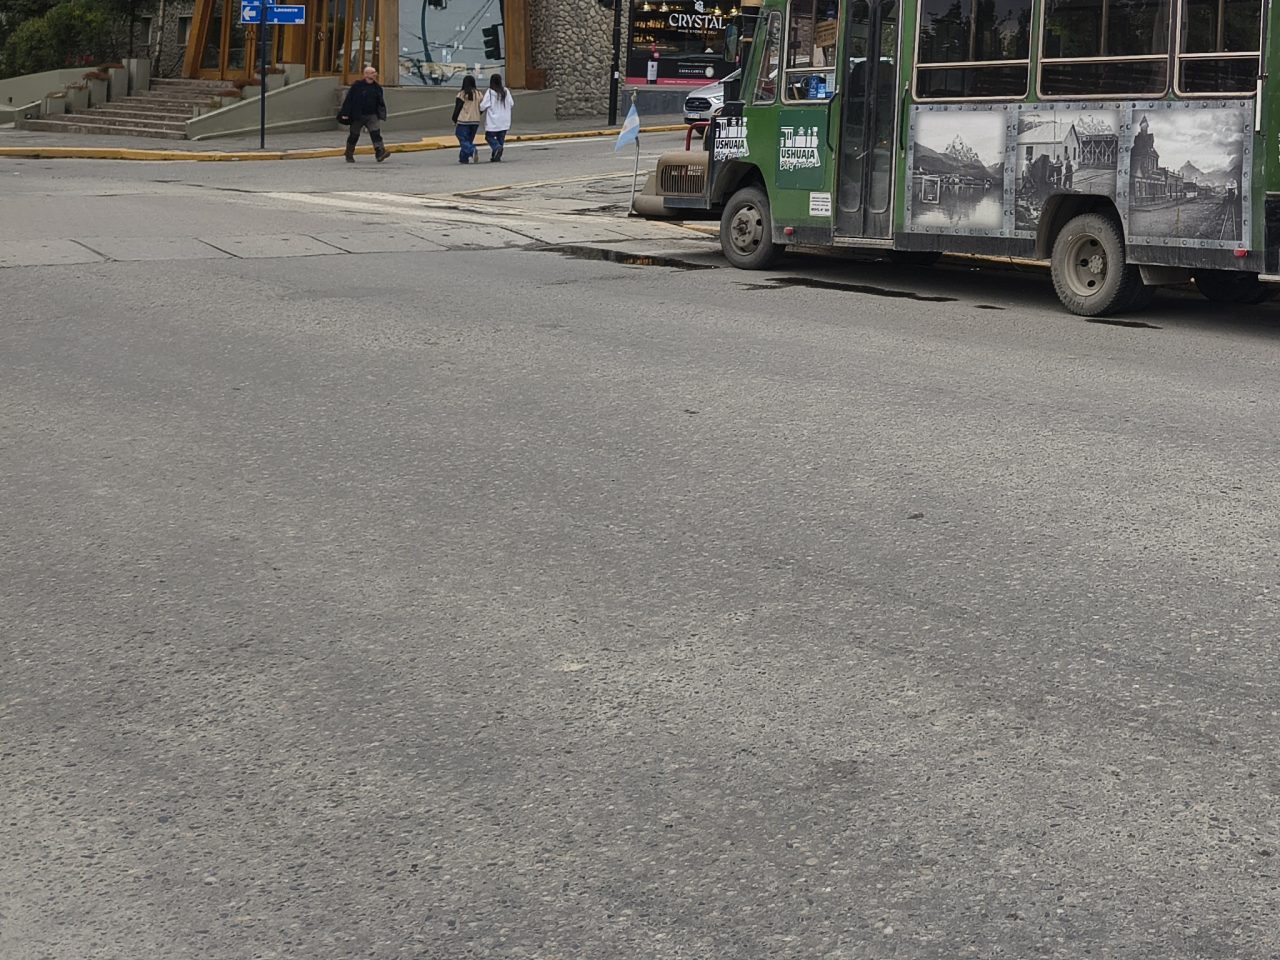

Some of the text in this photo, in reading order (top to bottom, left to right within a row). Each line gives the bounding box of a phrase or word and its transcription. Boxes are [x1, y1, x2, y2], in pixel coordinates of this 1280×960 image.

[669, 13, 726, 30] CRYSTAL
[716, 140, 744, 149] USHUAIA
[781, 149, 815, 159] USHUAIA
